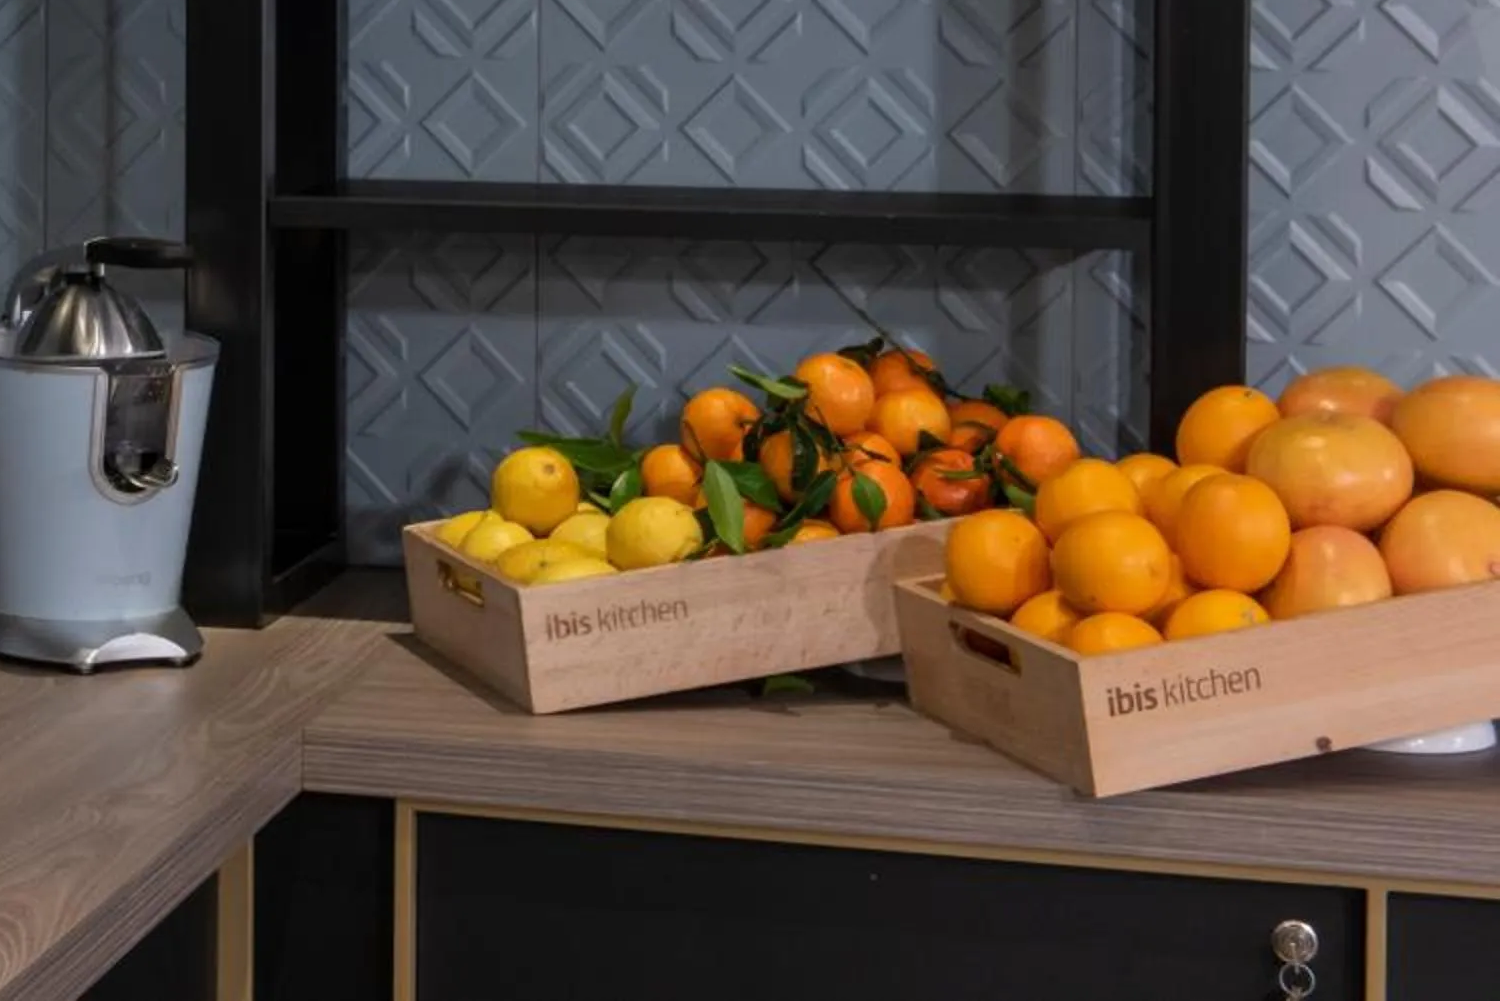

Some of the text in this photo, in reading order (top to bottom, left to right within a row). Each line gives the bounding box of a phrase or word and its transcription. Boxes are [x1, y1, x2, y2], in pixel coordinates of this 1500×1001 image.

[545, 599, 688, 641] ibis kitchen
[1106, 666, 1262, 717] ibis kitchen
